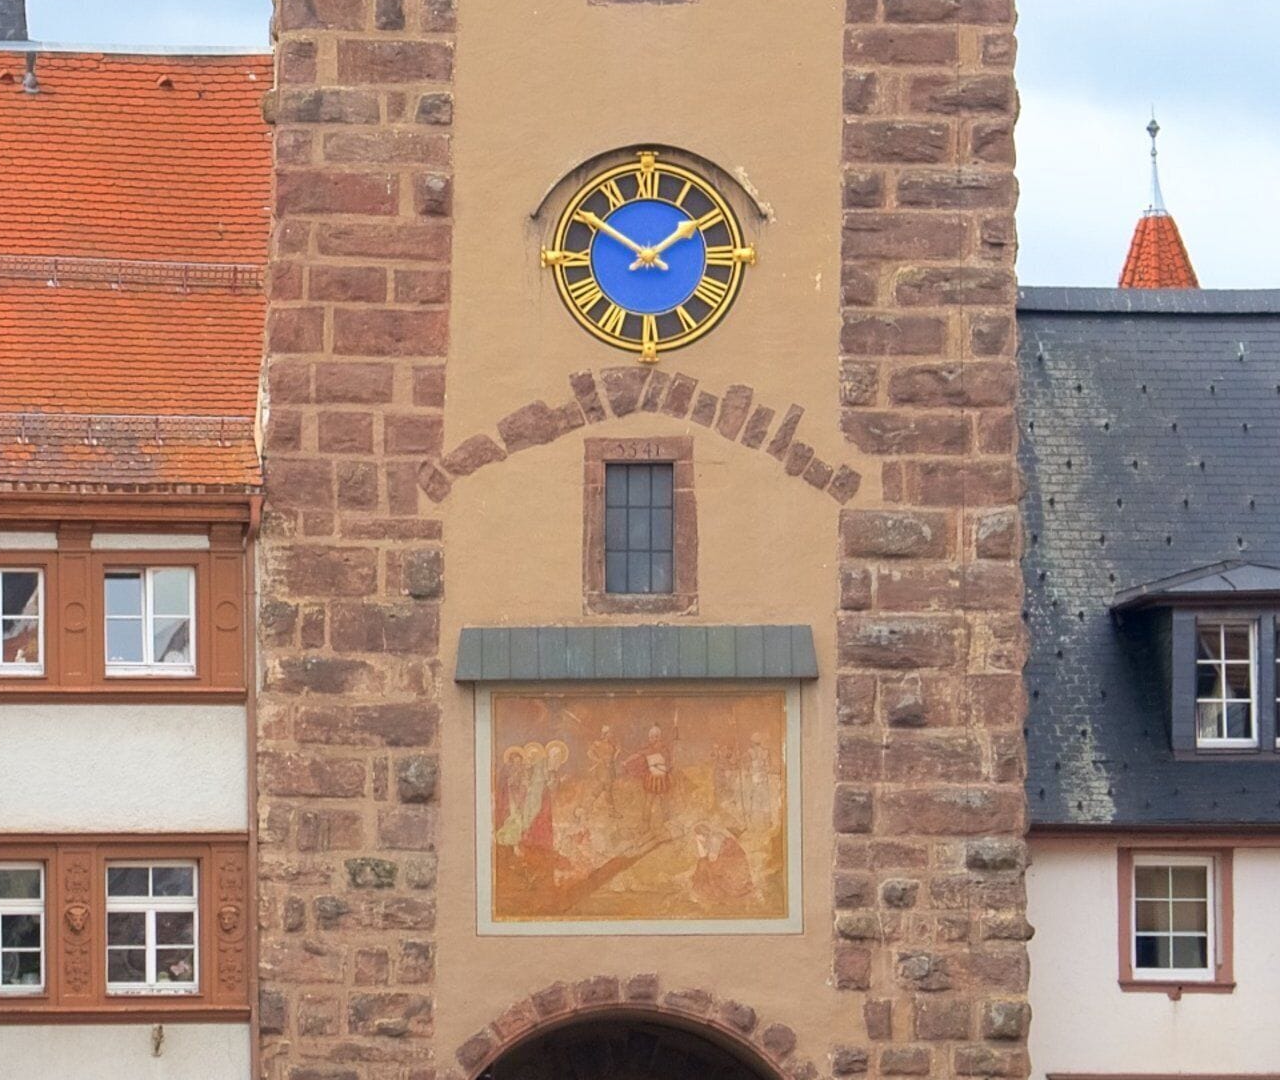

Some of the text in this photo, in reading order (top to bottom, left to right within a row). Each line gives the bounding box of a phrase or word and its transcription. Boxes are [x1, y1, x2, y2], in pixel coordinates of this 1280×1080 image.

[600, 180, 626, 211] XI
[636, 170, 660, 199] XII
[675, 179, 693, 207] I
[694, 206, 724, 232] II
[561, 248, 591, 267] IX
[705, 245, 734, 266] III
[676, 304, 698, 333] V
